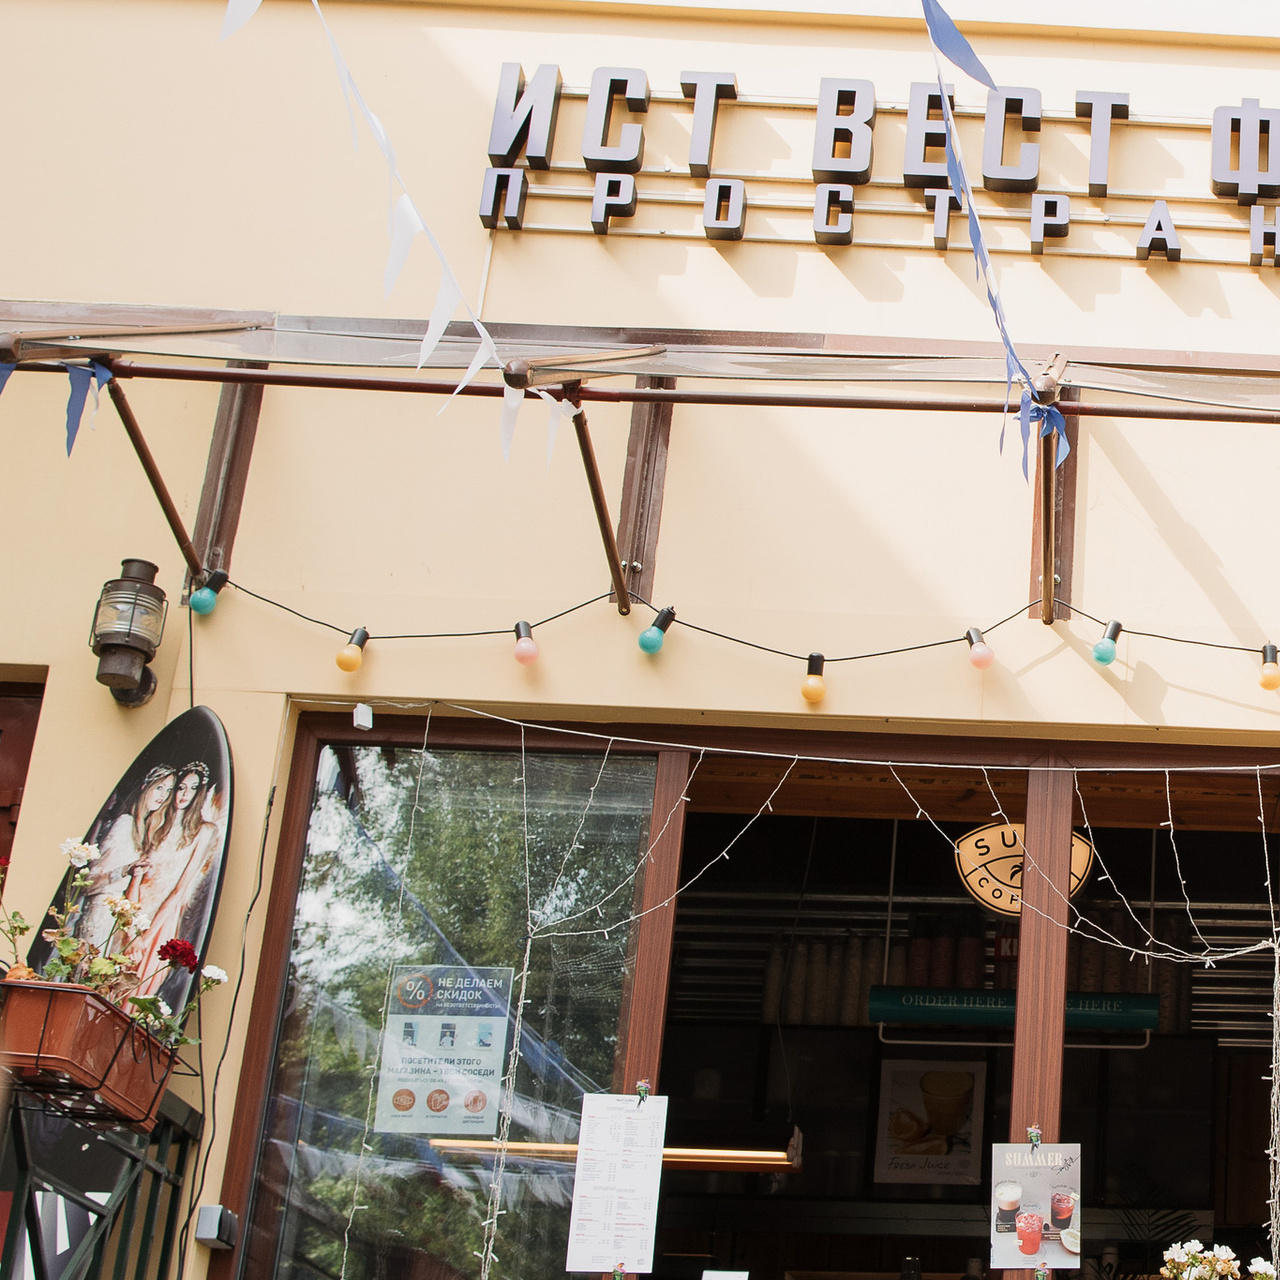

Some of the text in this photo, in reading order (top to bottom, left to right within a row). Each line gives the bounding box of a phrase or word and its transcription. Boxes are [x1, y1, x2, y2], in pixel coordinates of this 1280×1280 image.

[488, 62, 737, 178] ИСТ
[812, 77, 1129, 197] ВЕСТ
[974, 830, 1018, 857] SU
[978, 877, 1020, 906] COF
[438, 978, 453, 987] НЕ
[454, 978, 503, 989] ДЕЛАЕМ
[436, 989, 483, 1001] СКИДОК
[902, 994, 957, 1007] ORDER
[963, 995, 1007, 1008] HERE
[1079, 999, 1123, 1011] HERE
[456, 1058, 482, 1066] ЭТОГО
[462, 1068, 495, 1077] СОСЕДИ
[1005, 1152, 1063, 1166] SUMMER
